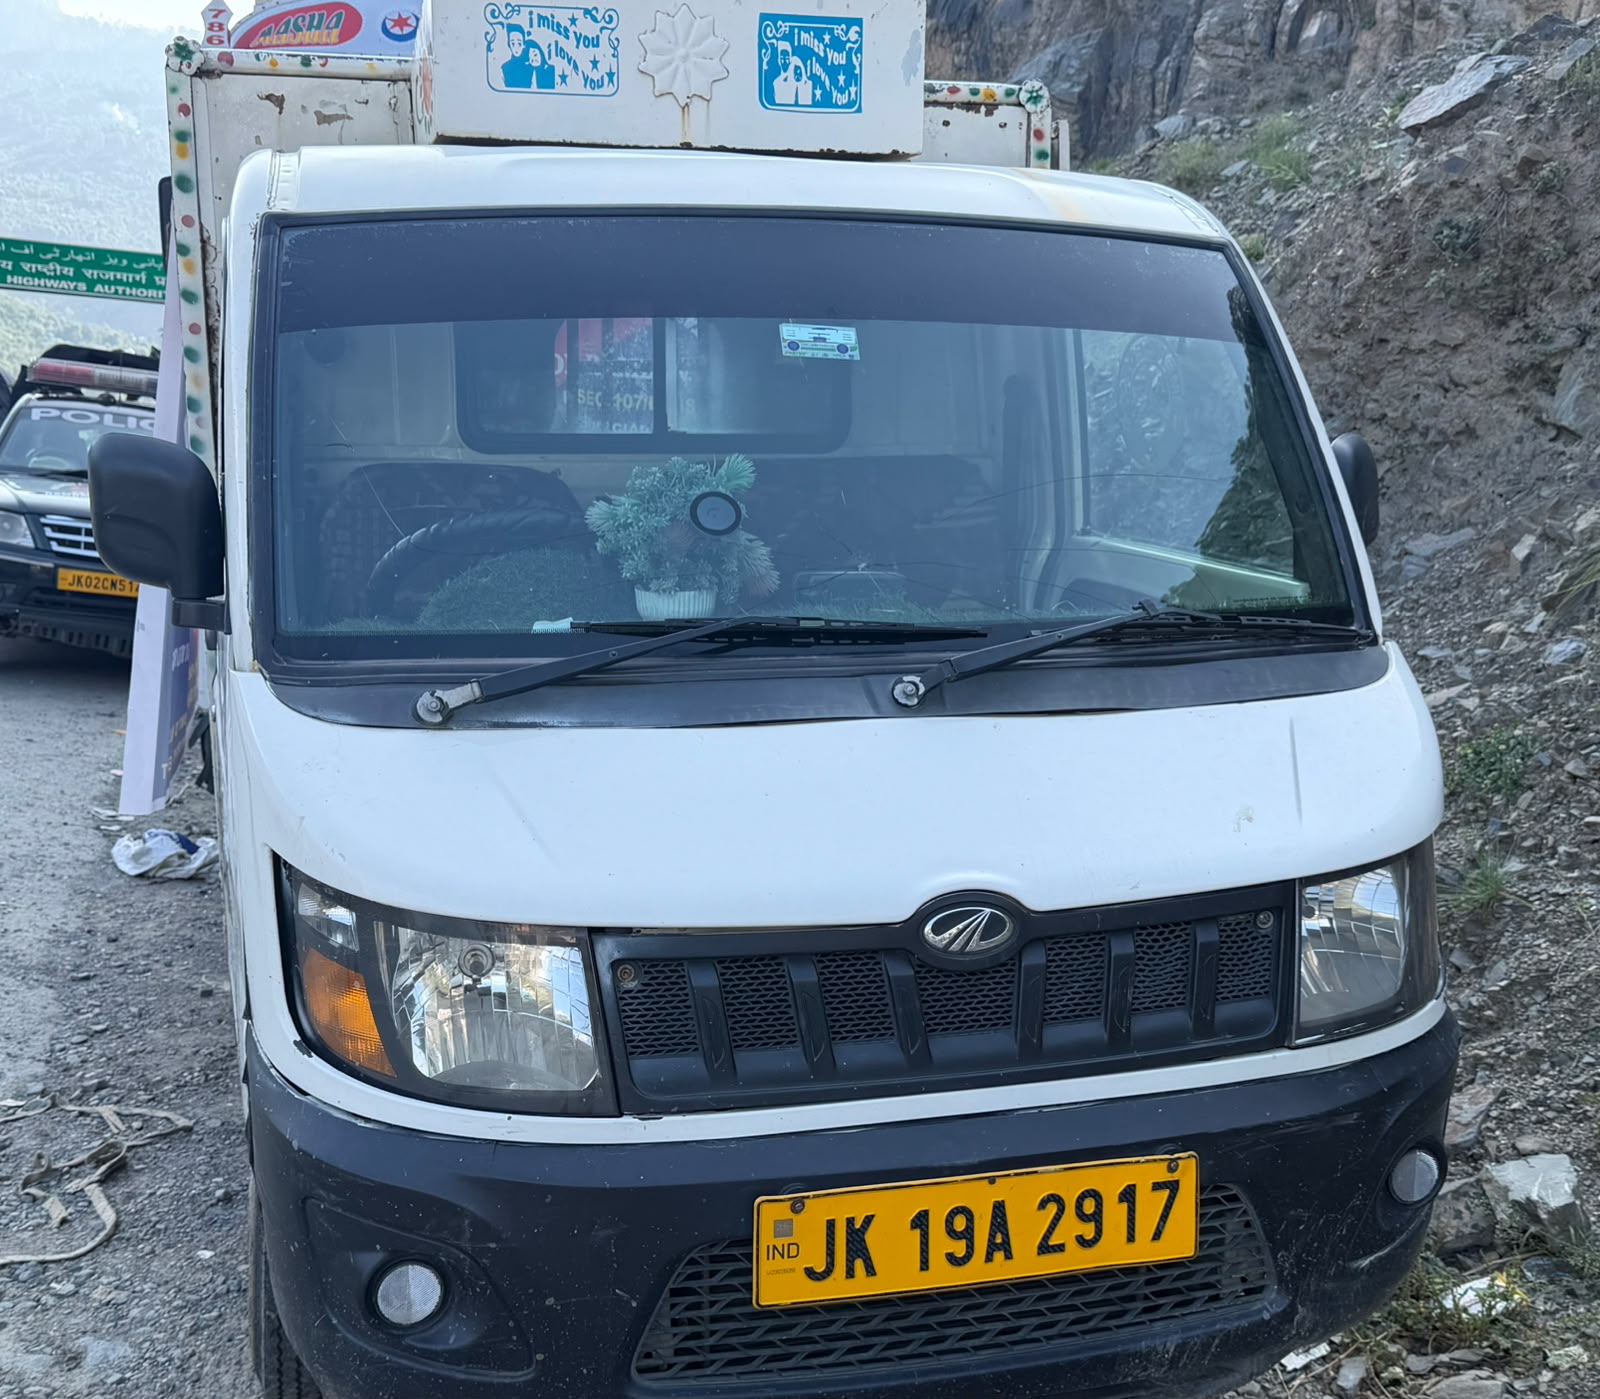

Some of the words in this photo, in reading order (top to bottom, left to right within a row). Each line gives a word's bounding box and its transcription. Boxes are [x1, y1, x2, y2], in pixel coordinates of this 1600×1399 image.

[537, 12, 571, 41] miss
[800, 30, 826, 57] miss
[554, 40, 580, 77] love
[812, 56, 831, 92] love
[6, 274, 87, 292] HIGHWAYS
[81, 267, 147, 285] राजमार्ग
[766, 1242, 800, 1261] IND
[803, 1213, 877, 1283] JK
[910, 1199, 1014, 1272] 19A
[1036, 1179, 1180, 1256] 2917
